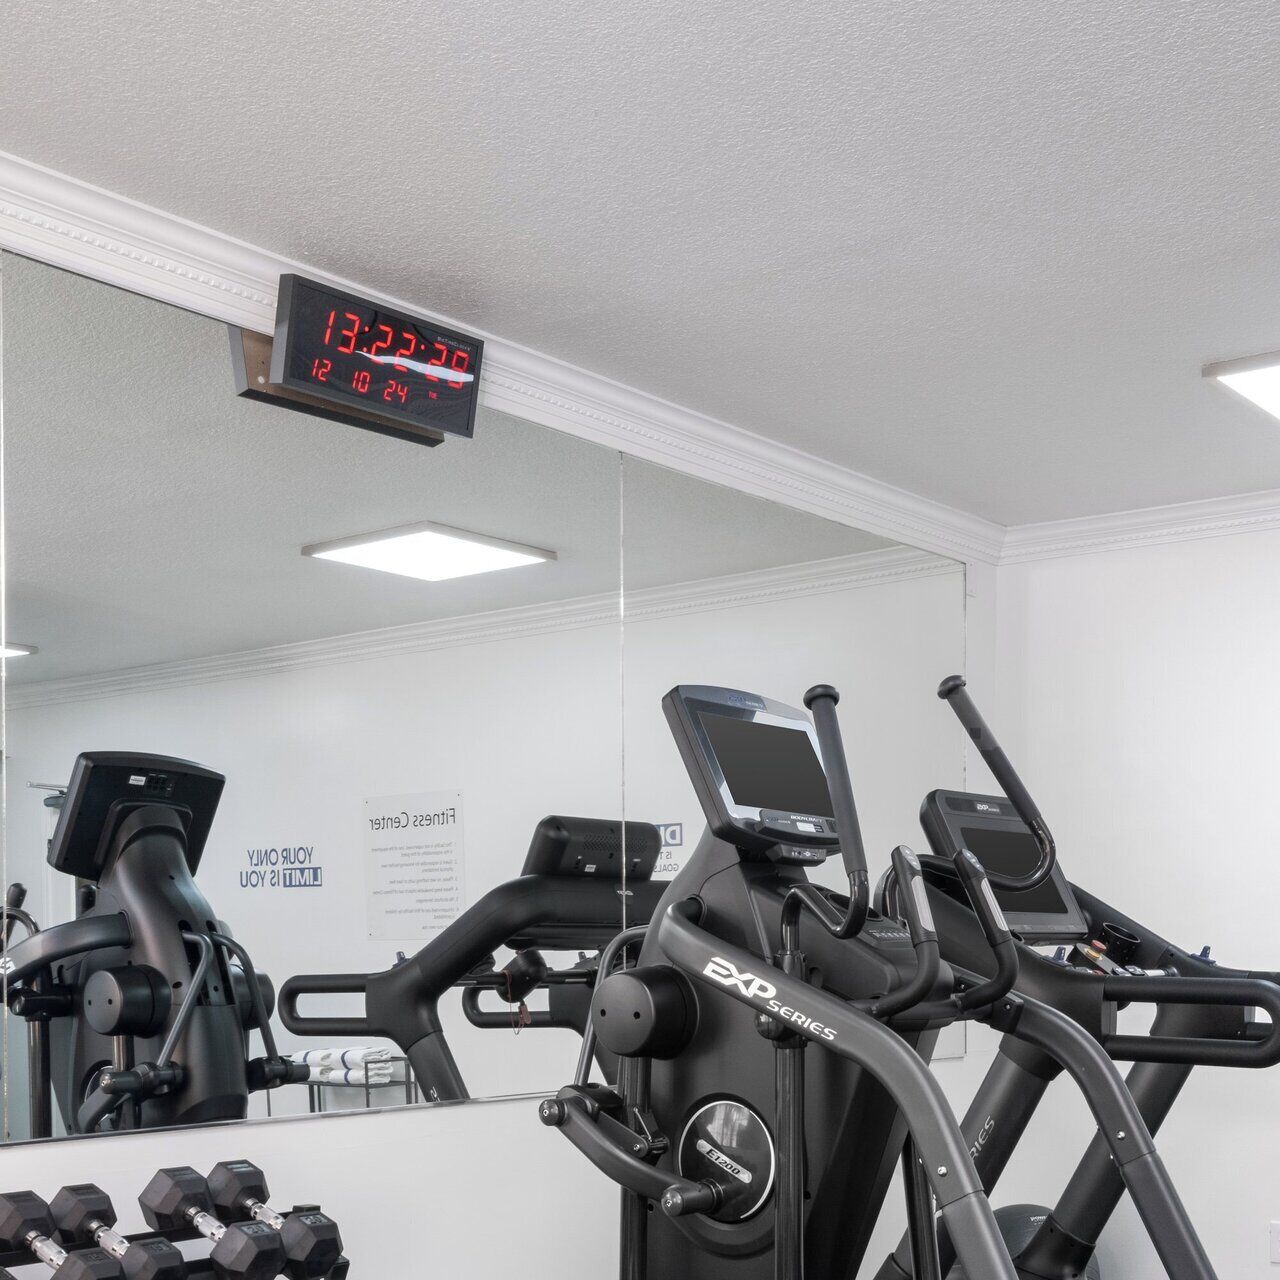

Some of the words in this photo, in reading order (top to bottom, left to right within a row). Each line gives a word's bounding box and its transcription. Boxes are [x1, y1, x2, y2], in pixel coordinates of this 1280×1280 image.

[311, 358, 332, 382] 12
[352, 369, 370, 393] 10
[384, 379, 409, 404] 24
[702, 956, 777, 999] EXP
[766, 999, 838, 1041] SERIES
[706, 1149, 741, 1176] E1200
[247, 1224, 264, 1234] 20
